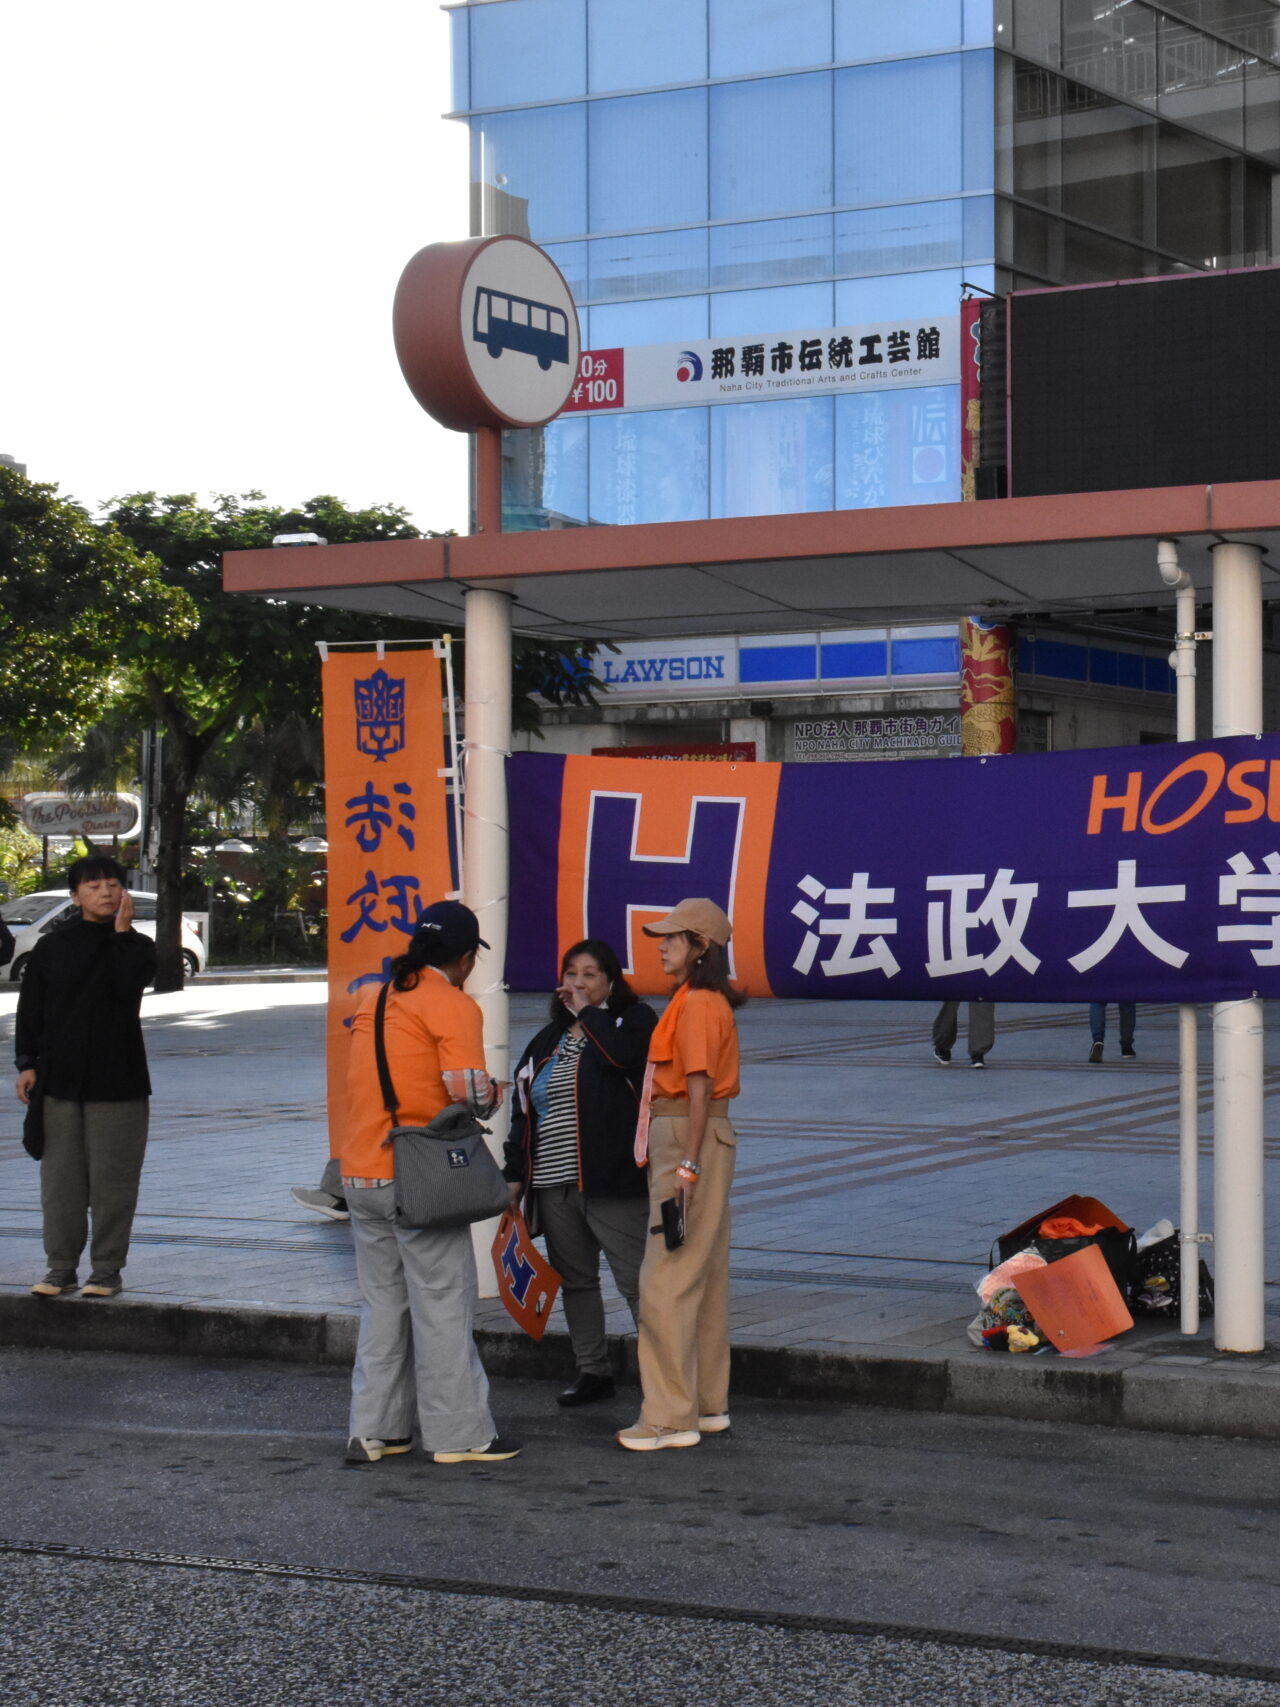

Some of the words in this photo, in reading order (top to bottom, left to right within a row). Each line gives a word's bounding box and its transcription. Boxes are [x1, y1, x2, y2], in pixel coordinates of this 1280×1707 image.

[711, 326, 941, 380] 那覇市伝統工芸館
[578, 355, 607, 378] 0分
[719, 383, 743, 393] Naha
[745, 380, 763, 391] City
[767, 376, 815, 388] Traditional
[818, 374, 836, 384] Arts
[839, 372, 857, 382] and
[859, 369, 888, 380] Crafts
[891, 366, 922, 377] Center
[603, 655, 725, 684] LAWSON
[794, 720, 851, 739] NPO法人
[794, 740, 815, 752] NPO
[817, 738, 846, 750] NAHA
[847, 737, 872, 749] CITY
[873, 735, 935, 749] MACHIKADO
